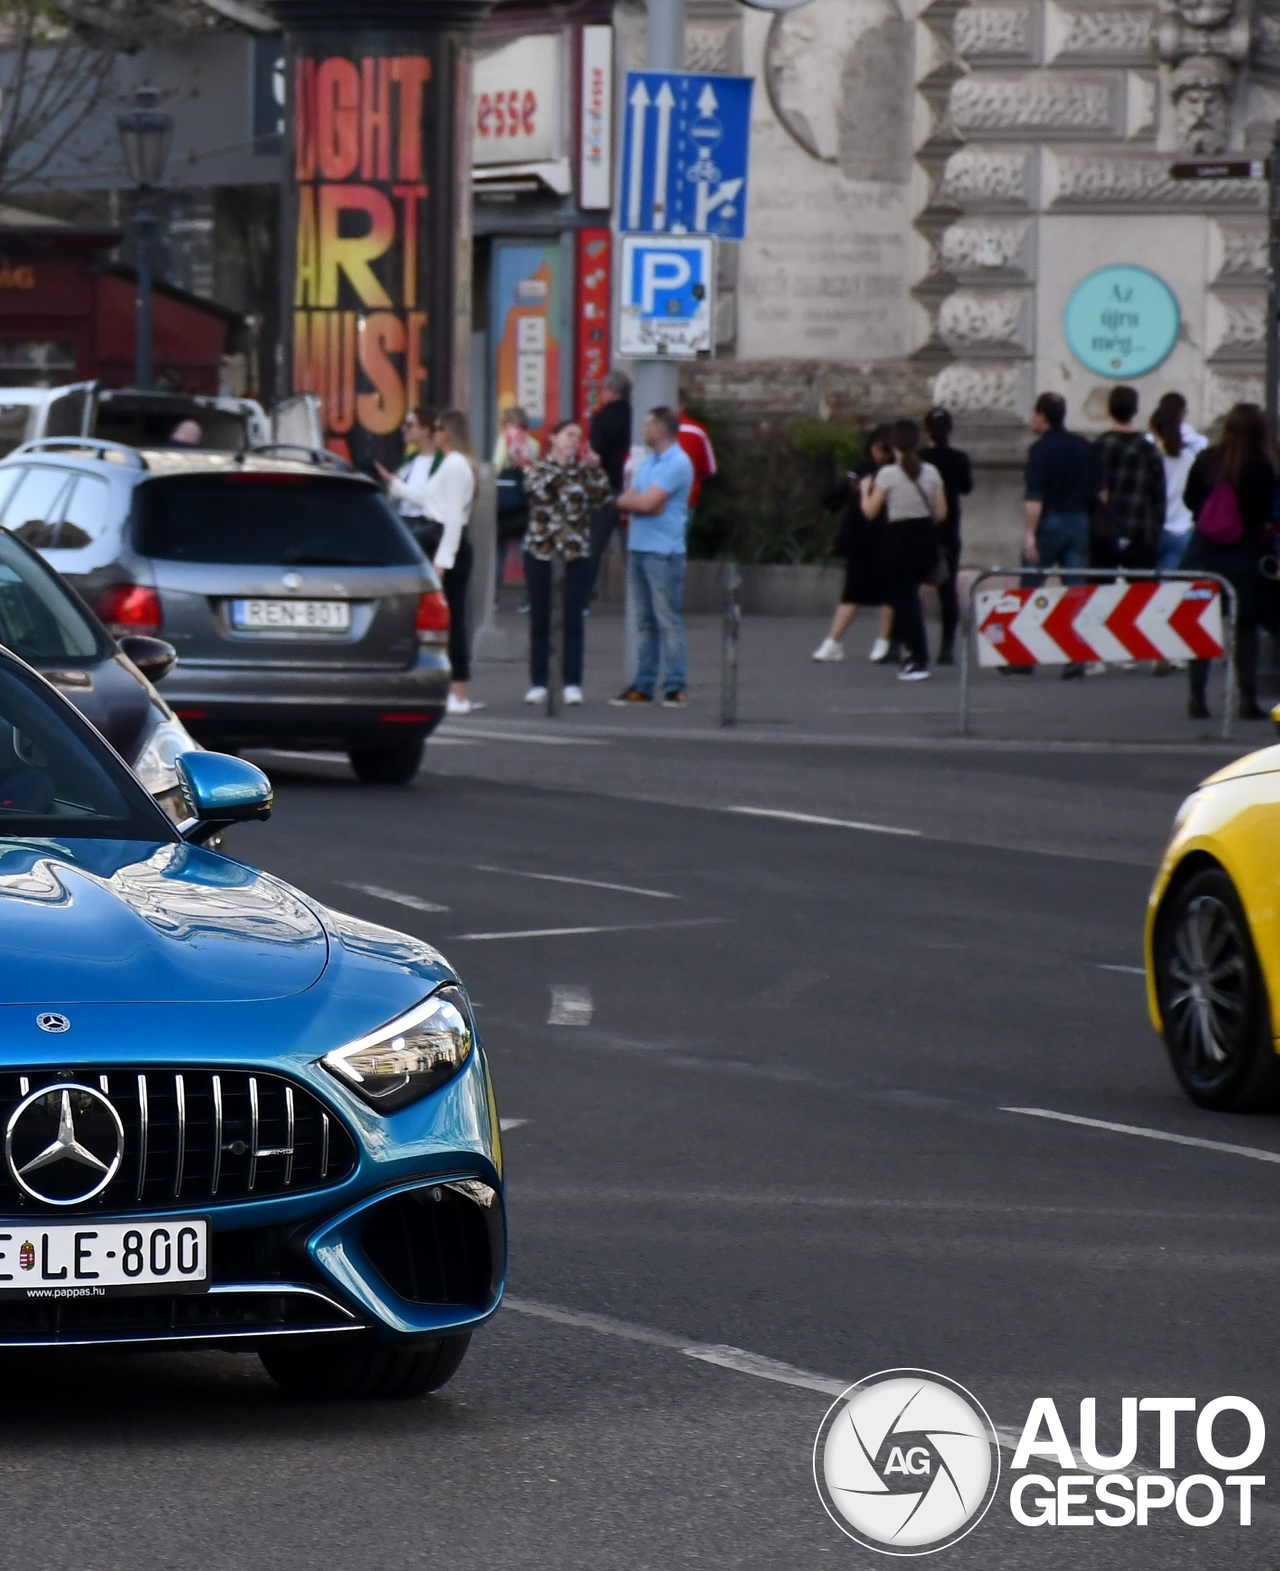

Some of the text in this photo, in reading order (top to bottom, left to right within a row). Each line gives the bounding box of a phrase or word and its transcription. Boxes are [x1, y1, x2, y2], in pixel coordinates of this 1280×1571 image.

[295, 184, 429, 307] ART
[643, 253, 691, 313] P
[250, 602, 344, 624] REN-801
[41, 1227, 199, 1280] LE-800
[27, 1286, 106, 1299] www.pappas.hu
